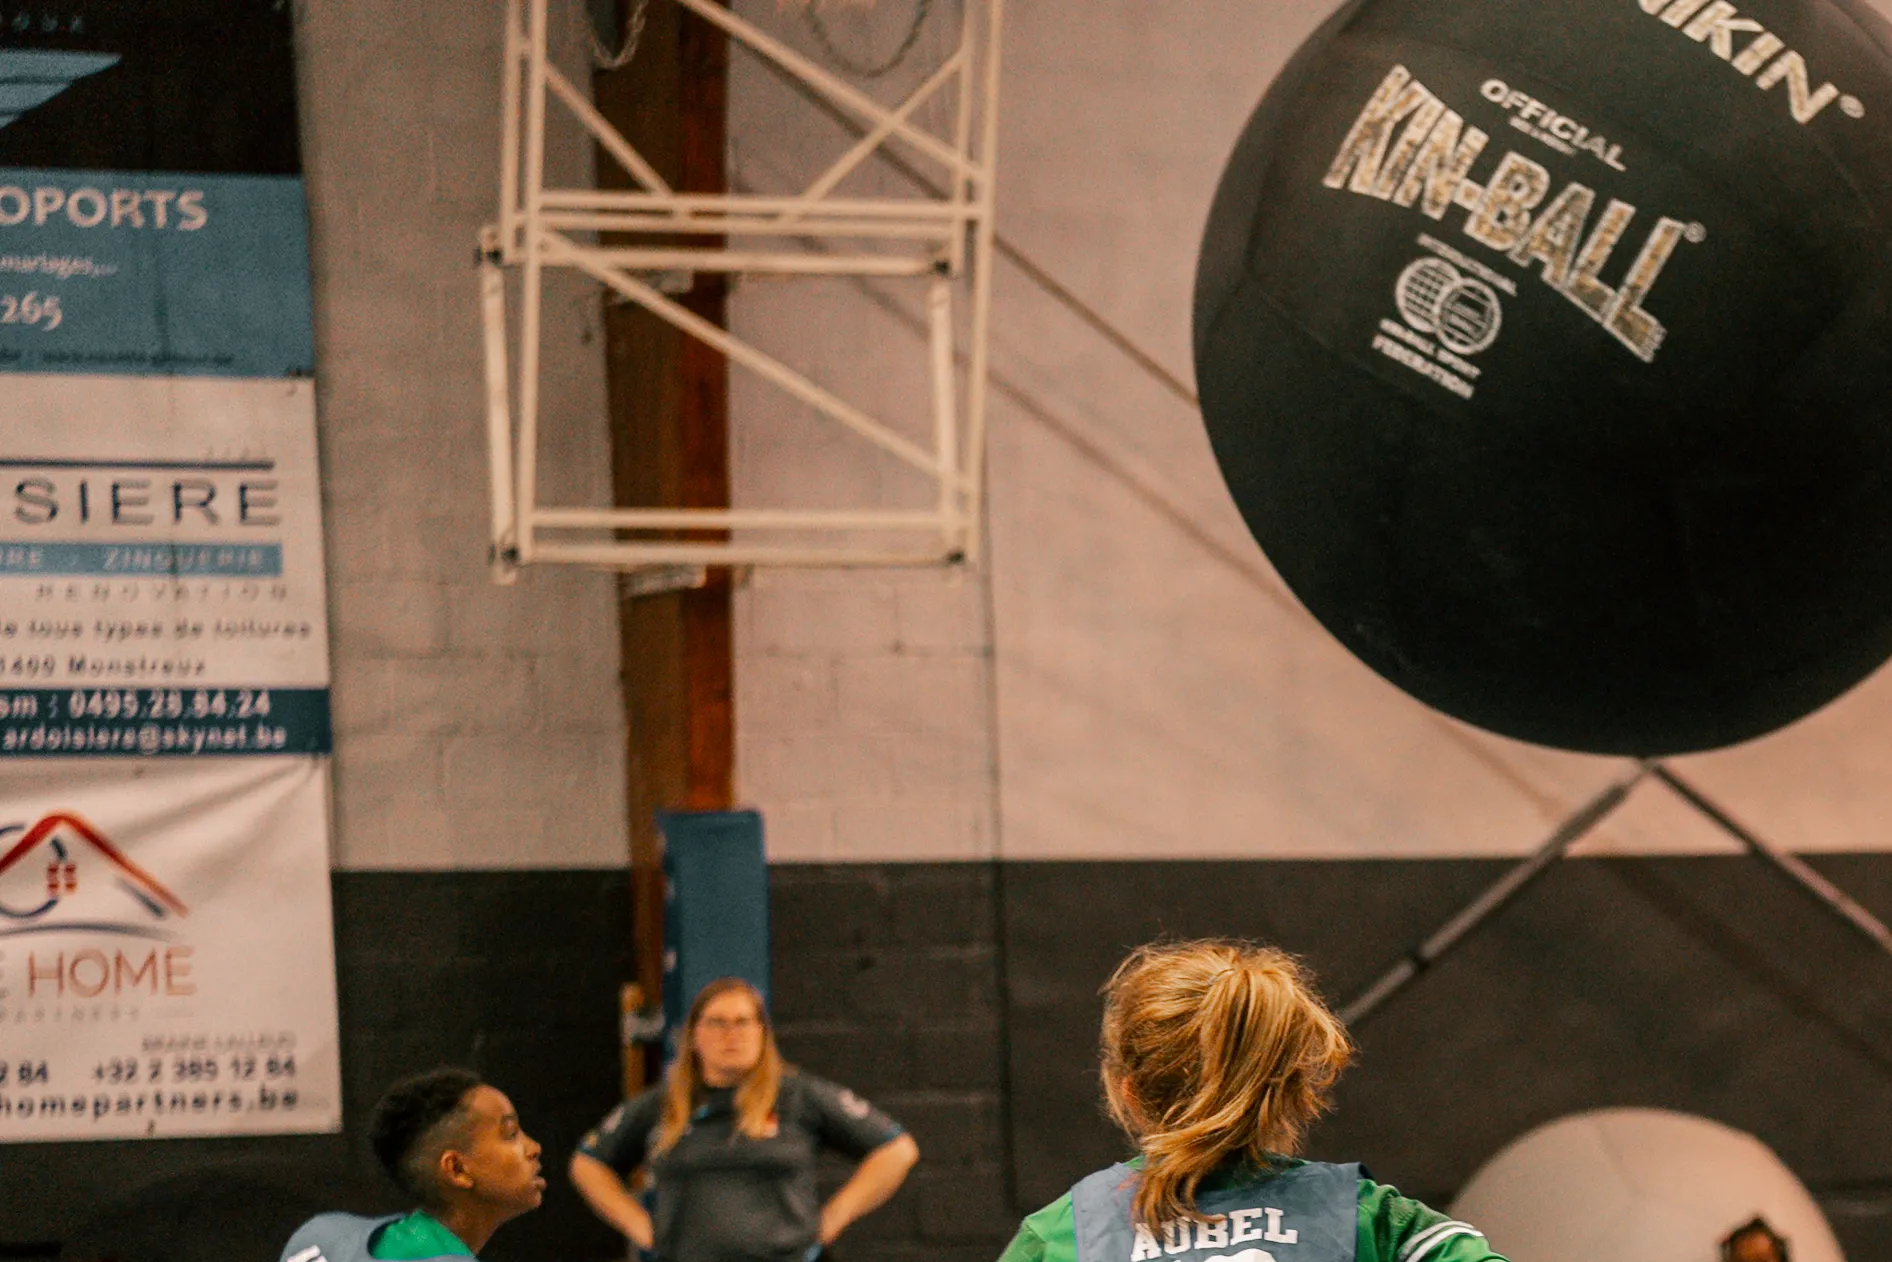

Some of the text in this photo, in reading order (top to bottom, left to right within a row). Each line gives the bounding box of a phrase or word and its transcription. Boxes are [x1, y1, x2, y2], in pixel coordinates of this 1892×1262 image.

[1479, 77, 1627, 172] OFFICIAL
[14, 478, 282, 526] SIERE
[27, 947, 198, 998] HOME
[1130, 1207, 1298, 1262] AUBEL
